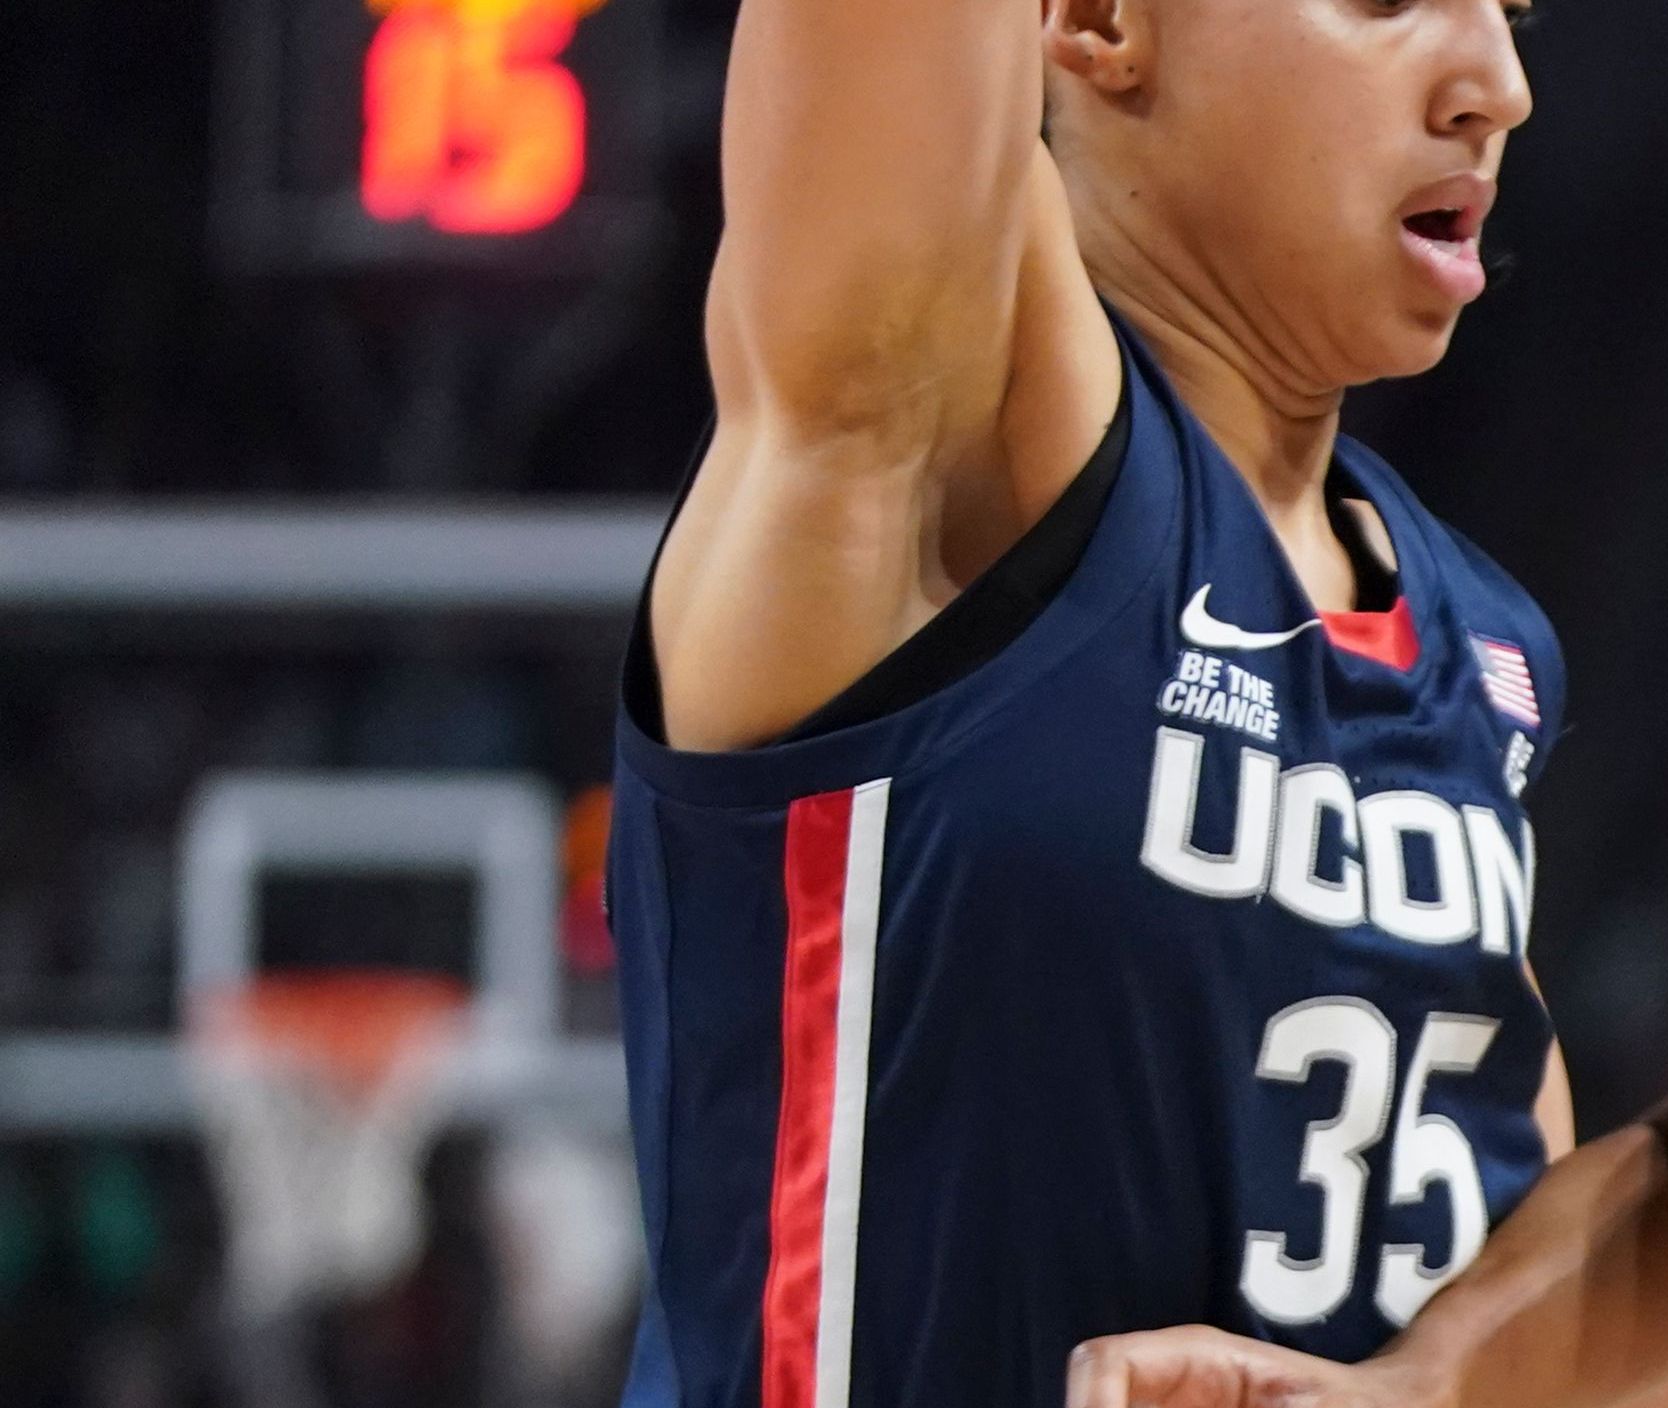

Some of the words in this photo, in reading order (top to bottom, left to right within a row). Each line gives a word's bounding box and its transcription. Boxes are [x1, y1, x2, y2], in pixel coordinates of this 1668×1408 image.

[1161, 679, 1281, 741] CHANGE
[1178, 651, 1222, 689] BE
[1227, 663, 1274, 709] THE
[1240, 995, 1500, 1329] 35
